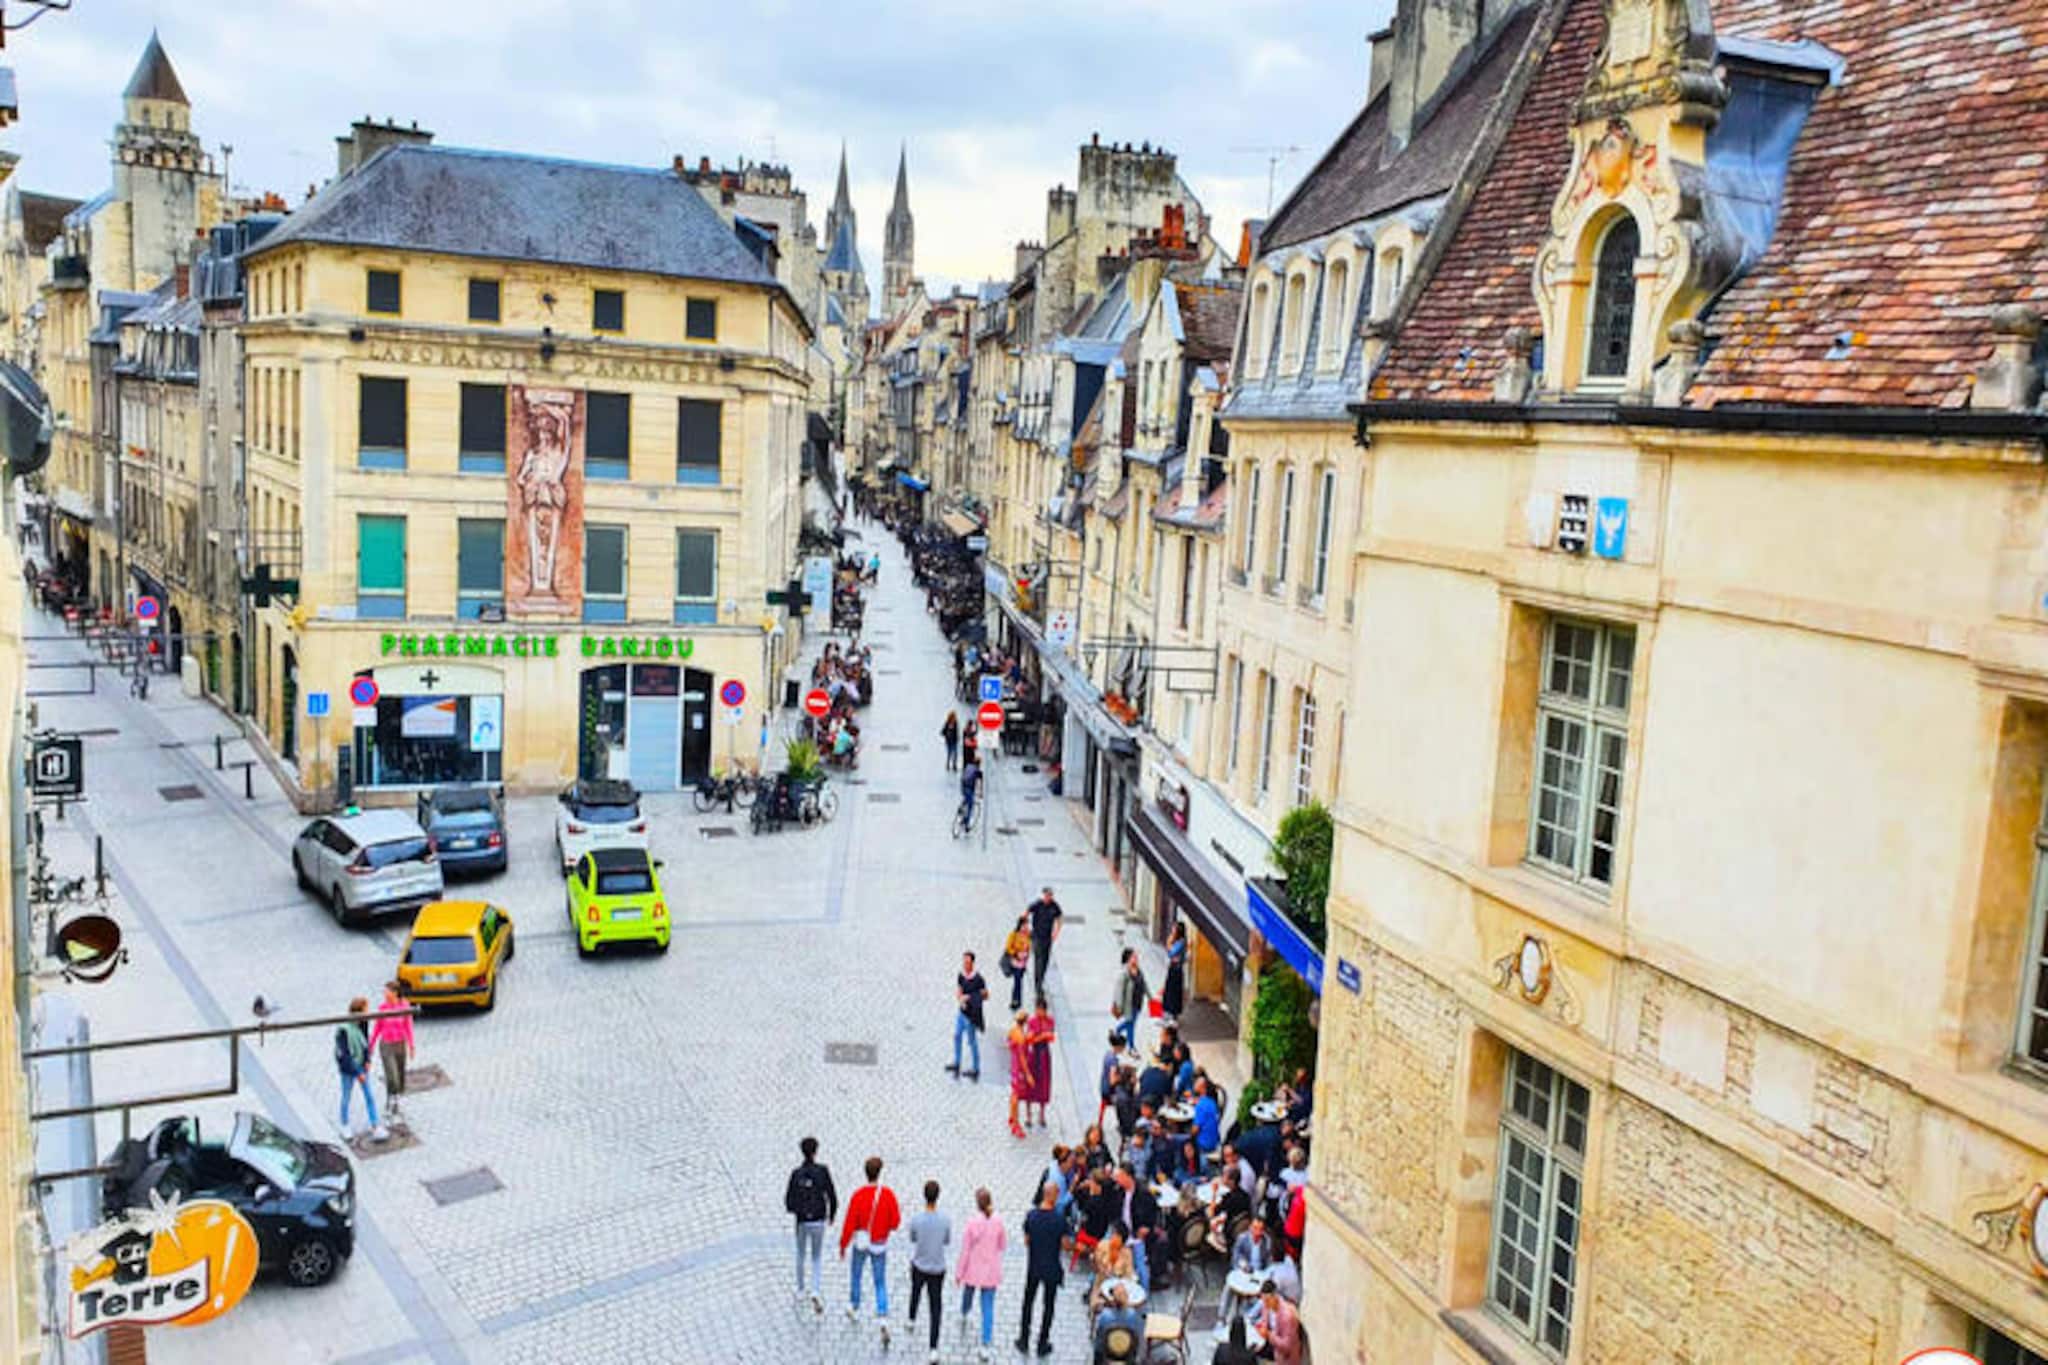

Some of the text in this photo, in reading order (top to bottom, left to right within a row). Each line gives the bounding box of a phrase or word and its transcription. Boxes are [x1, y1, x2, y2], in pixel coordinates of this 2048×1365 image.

[381, 633, 694, 659] PHARMACIE DANJOU
[79, 1279, 200, 1322] Terre
